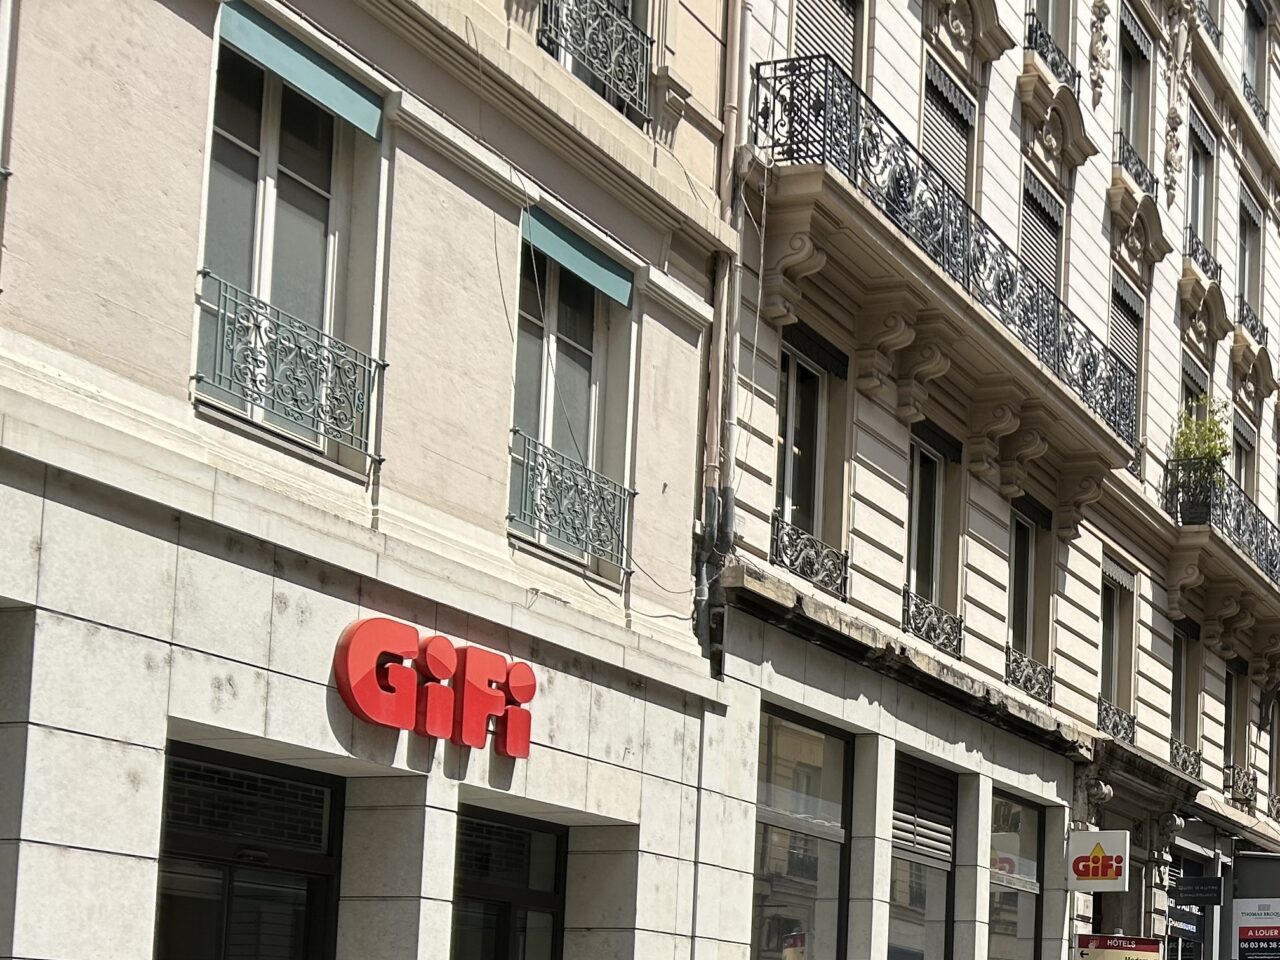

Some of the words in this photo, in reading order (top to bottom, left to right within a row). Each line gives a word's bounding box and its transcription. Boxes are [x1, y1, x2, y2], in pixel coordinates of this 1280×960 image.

[335, 617, 537, 759] GiFi
[1072, 855, 1123, 877] GiFi
[1107, 938, 1136, 948] HÔTELS
